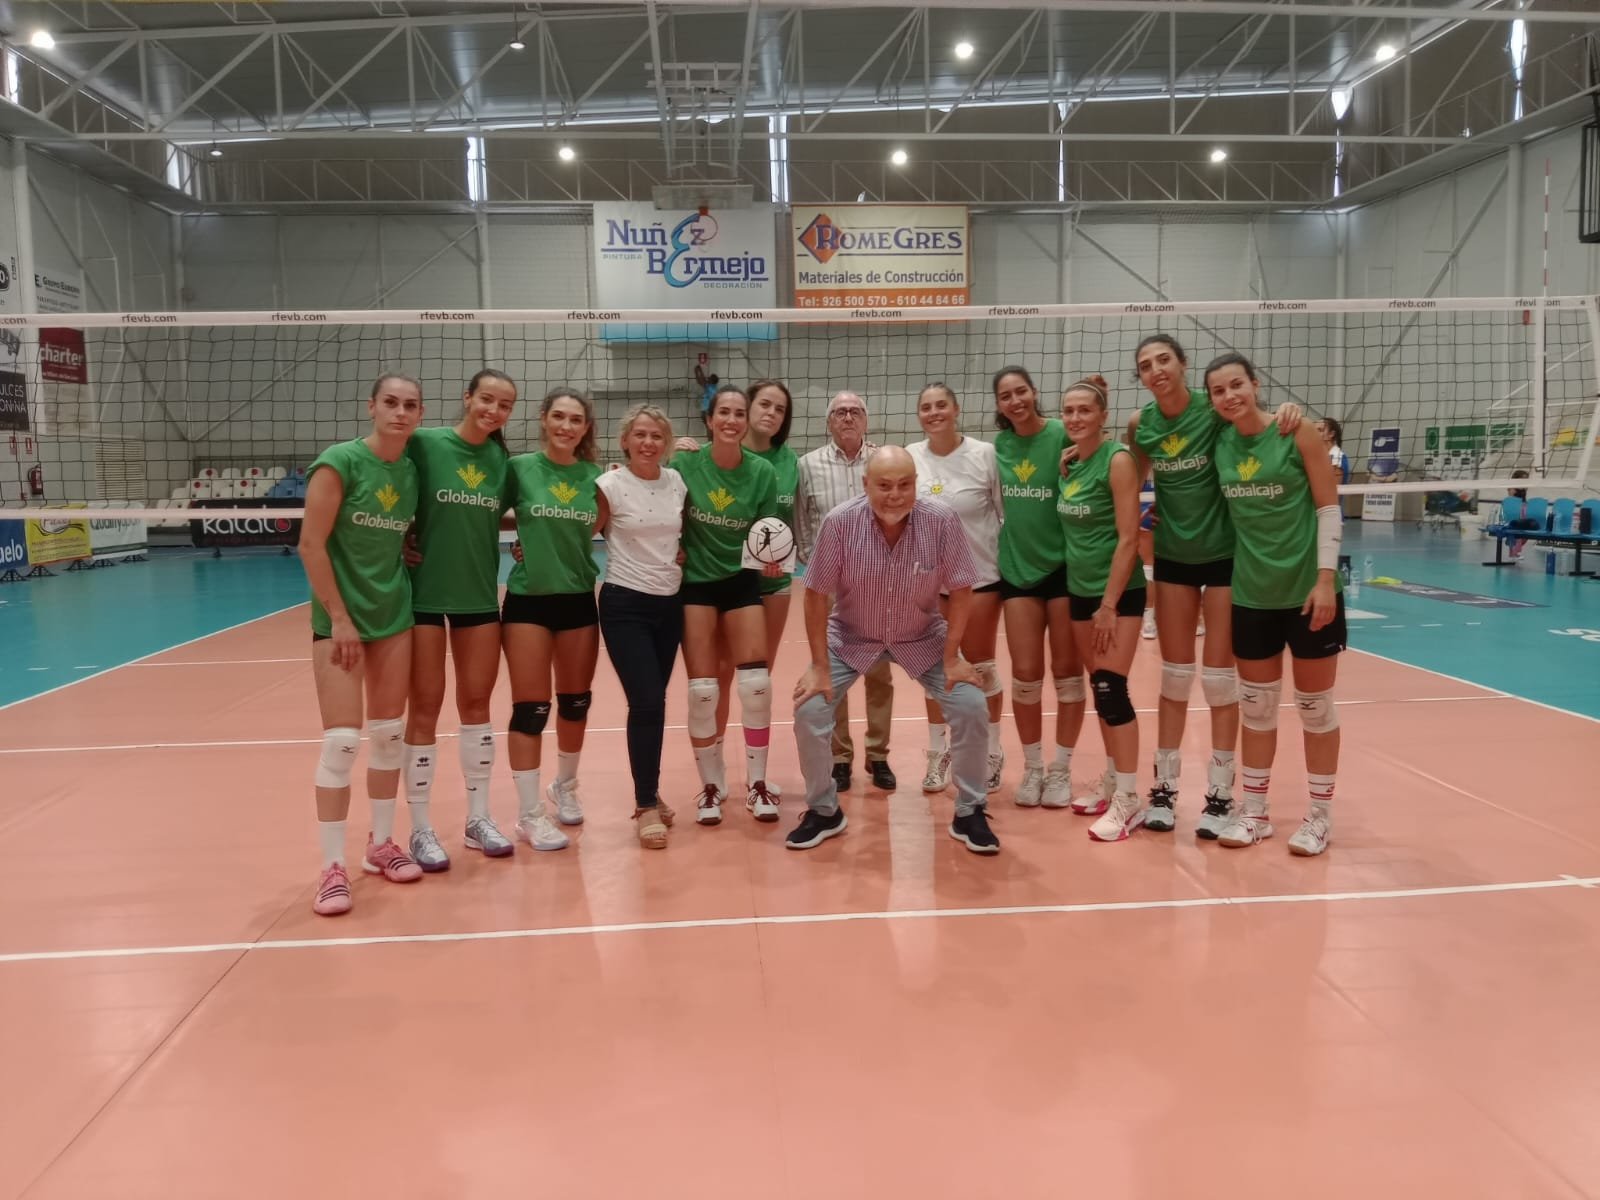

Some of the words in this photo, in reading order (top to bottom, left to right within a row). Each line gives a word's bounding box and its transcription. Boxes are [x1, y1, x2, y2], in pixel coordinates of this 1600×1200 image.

[799, 271, 862, 284] Materiales
[866, 270, 881, 283] de
[884, 269, 964, 283] Construcción
[798, 296, 819, 307] Tel:
[822, 296, 841, 306] 926
[845, 296, 864, 306] 500
[868, 296, 887, 306] 570
[897, 296, 916, 306] 610
[919, 295, 933, 305] 44
[936, 295, 949, 305] 84
[952, 295, 965, 305] 66
[1259, 301, 1307, 310] rfevb.com
[1389, 299, 1436, 309] rfevb.com
[851, 309, 902, 318] rfevb.com
[988, 306, 1039, 316] rfevb.com
[1125, 304, 1175, 313] rfevb.com
[121, 313, 177, 324] rfevb.com
[271, 312, 326, 322] rfevb.com
[420, 311, 475, 321] rfevb.com
[567, 311, 621, 320] rfevb.com
[711, 311, 763, 320] rfevb.com
[530, 503, 597, 526] Globalcaja
[690, 506, 748, 529] Globalcaja
